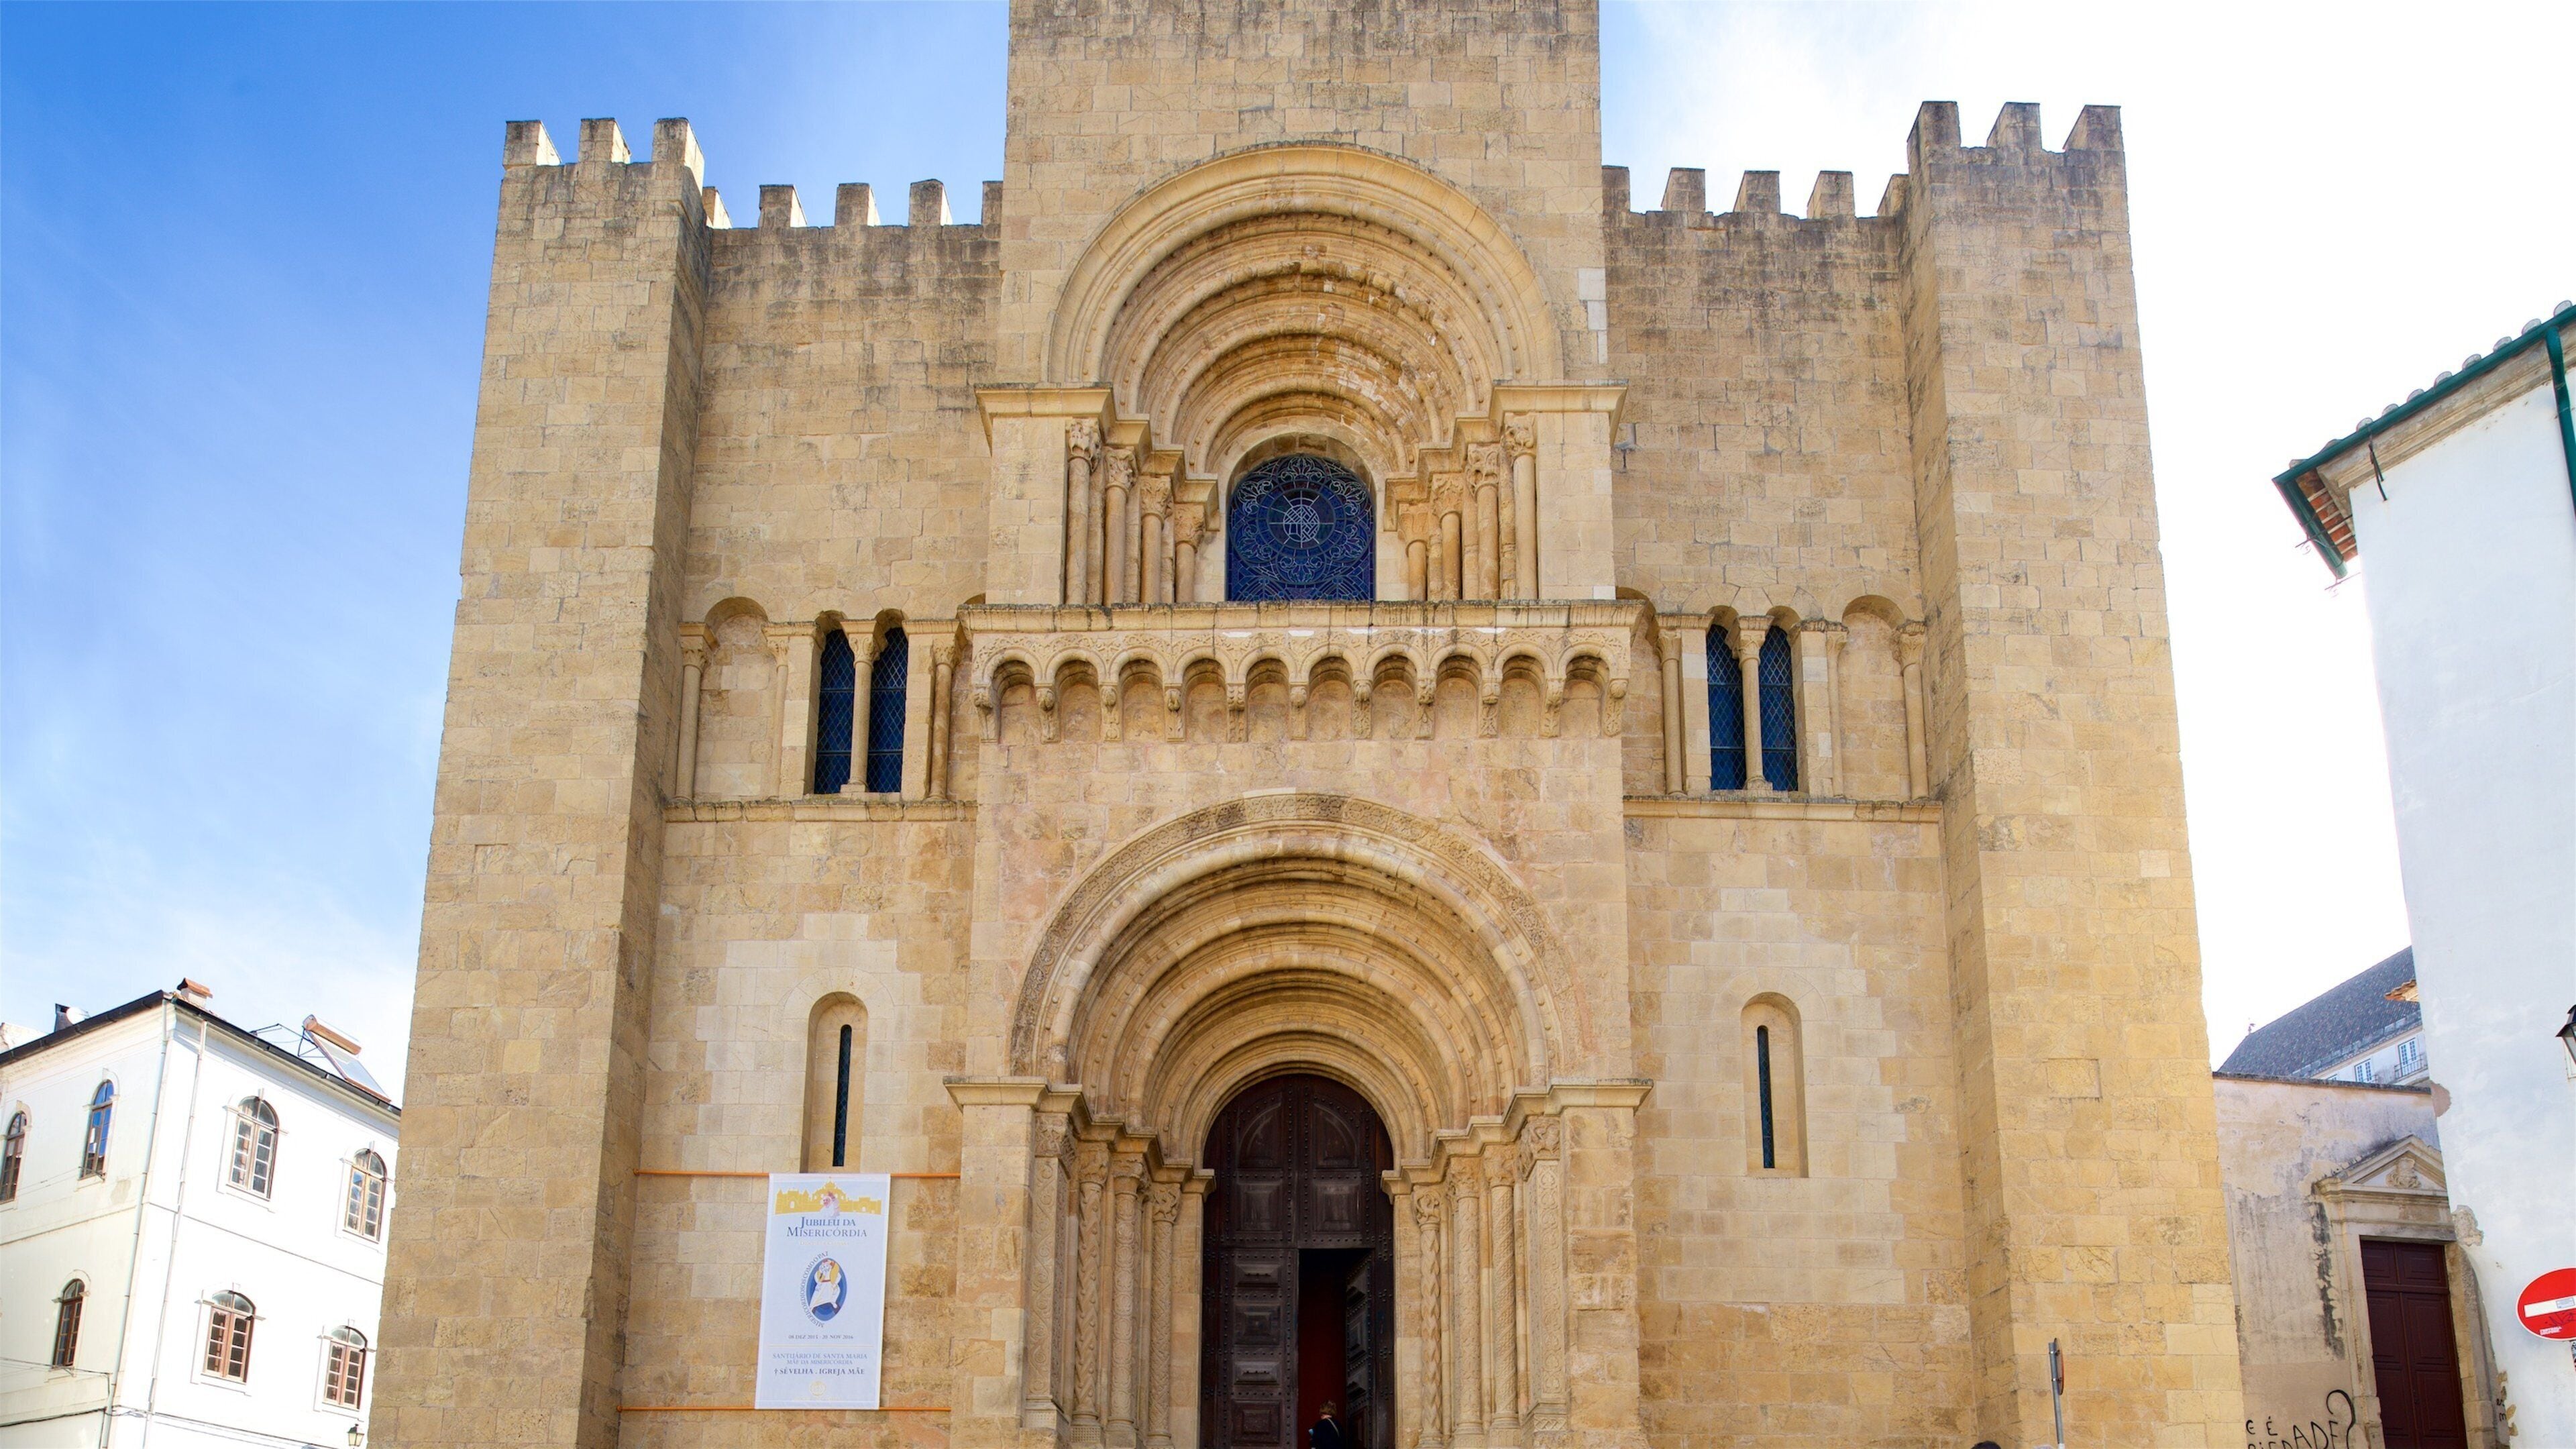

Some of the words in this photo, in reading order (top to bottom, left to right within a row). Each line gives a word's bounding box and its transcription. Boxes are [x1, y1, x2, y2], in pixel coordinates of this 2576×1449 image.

[786, 1226, 867, 1237] MISERICÓRDIA
[819, 1368, 845, 1376] IGREJA
[847, 1366, 865, 1375] MÃE
